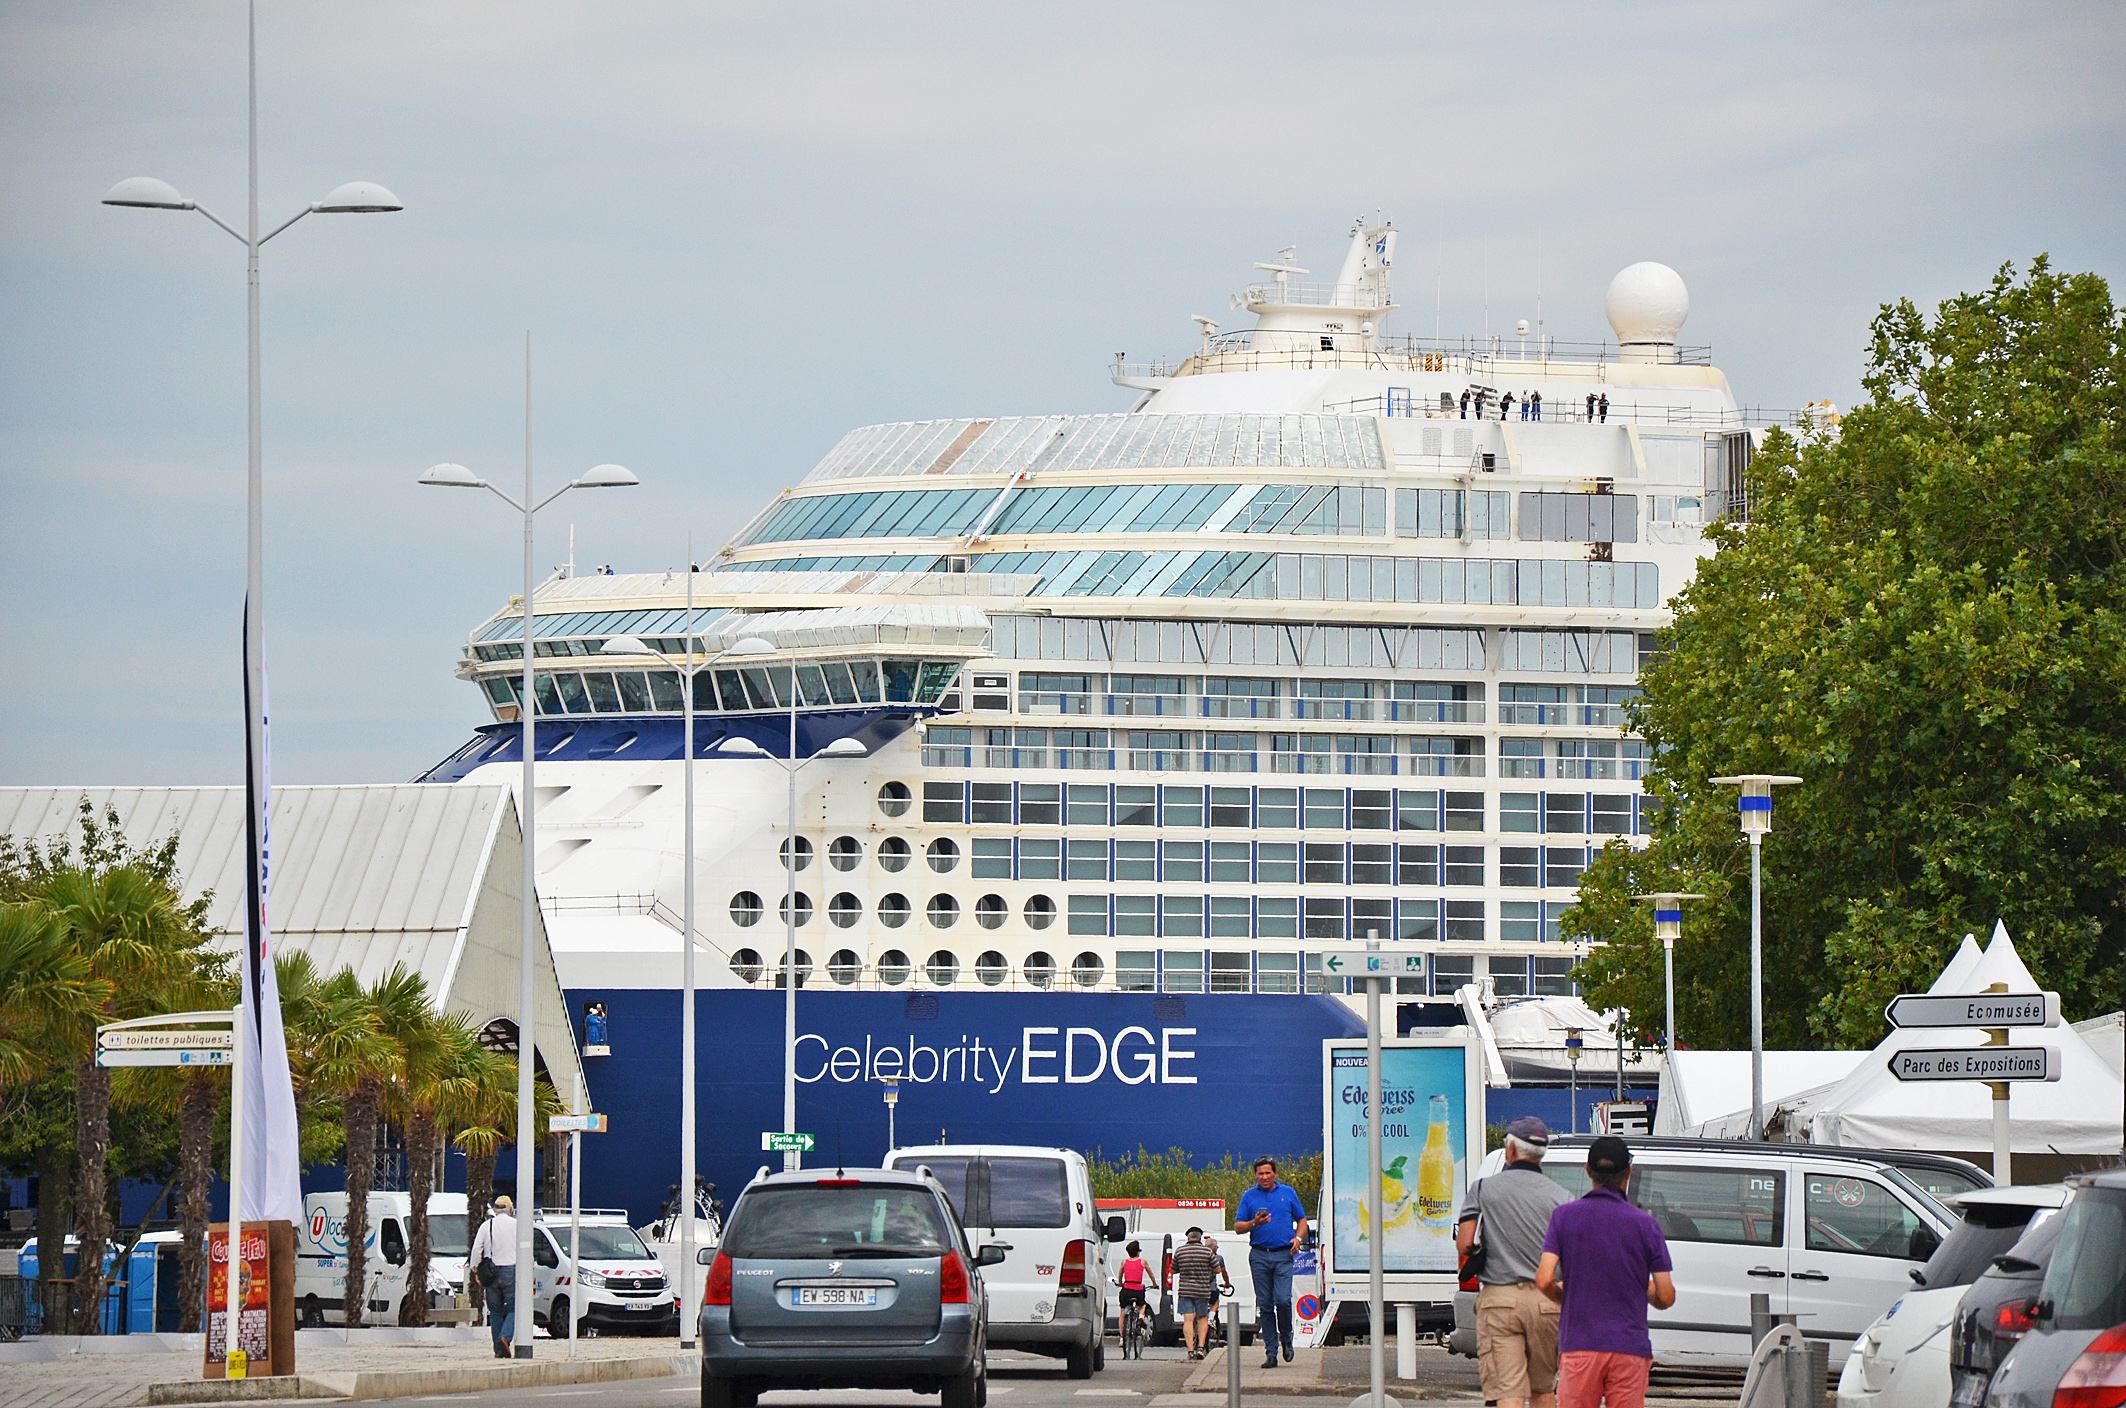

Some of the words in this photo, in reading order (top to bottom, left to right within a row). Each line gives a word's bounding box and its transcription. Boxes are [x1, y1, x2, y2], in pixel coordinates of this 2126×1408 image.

[1967, 1003, 2040, 1019] Ecomusée
[126, 1035, 170, 1045] toilettes
[173, 1035, 222, 1046] publiques
[794, 1033, 1016, 1094] Celebrity
[1021, 1025, 1198, 1085] EDGE
[1336, 1058, 1369, 1067] NOUVEA
[1903, 1058, 1931, 1073] Parc
[1938, 1057, 1959, 1073] des
[1966, 1055, 2041, 1075] Expositions
[770, 1134, 793, 1143] Sortie
[795, 1135, 805, 1143] de
[773, 1142, 802, 1150] Secours
[312, 1216, 325, 1236] U
[317, 1259, 334, 1268] SUPER
[803, 1289, 865, 1303] EW-598-NA
